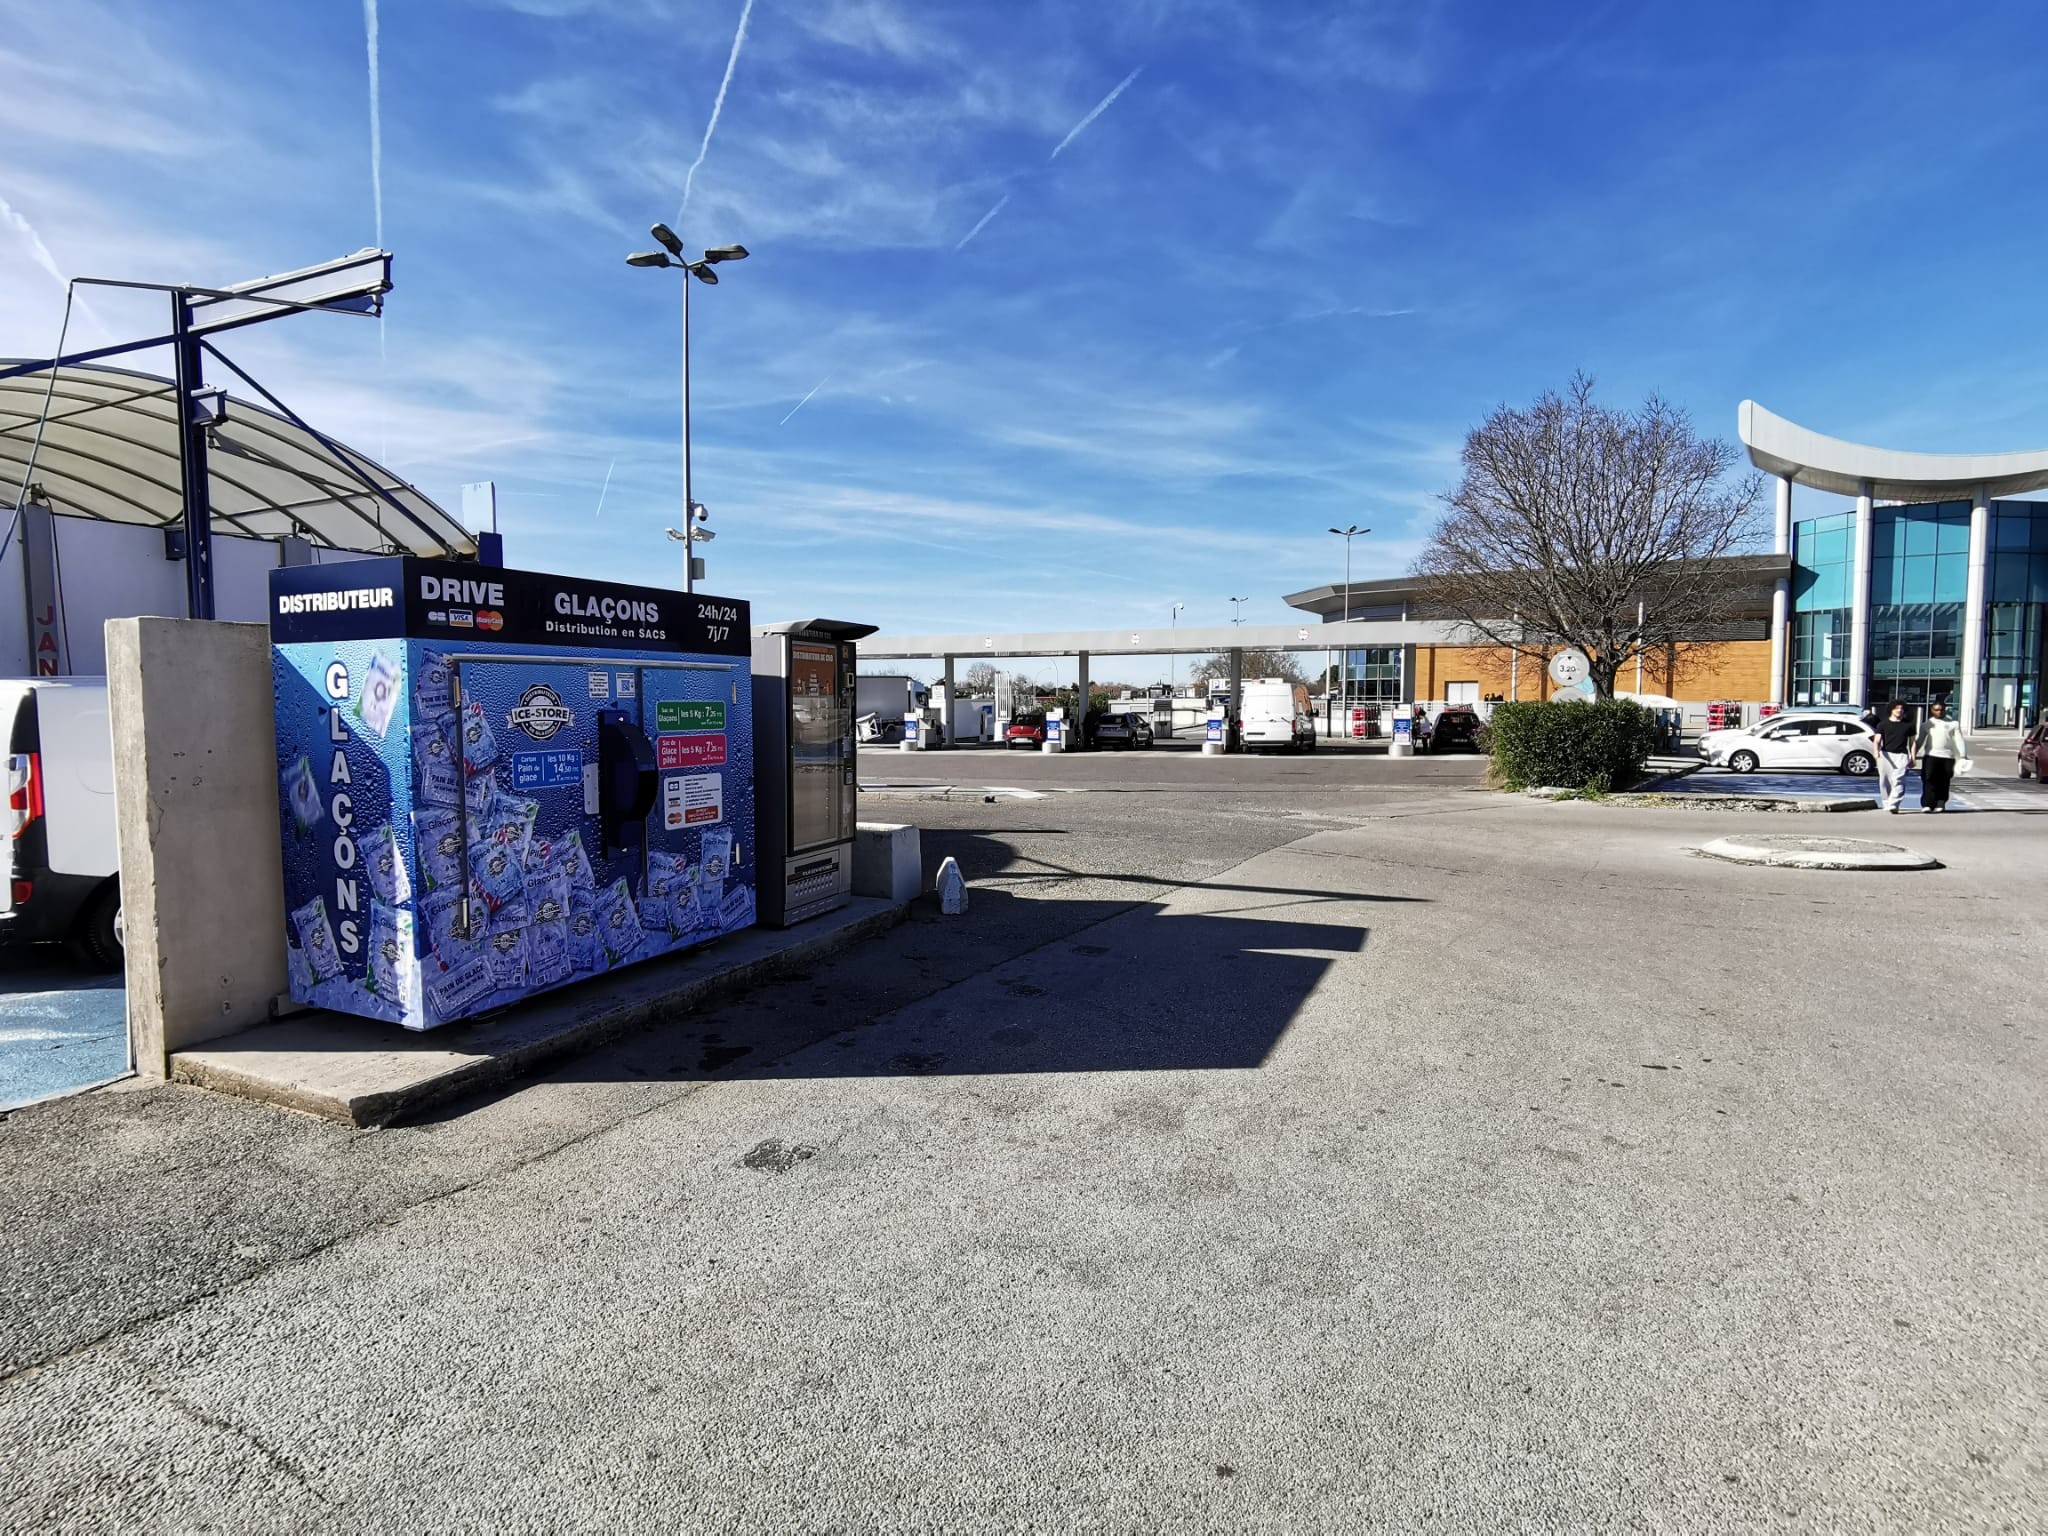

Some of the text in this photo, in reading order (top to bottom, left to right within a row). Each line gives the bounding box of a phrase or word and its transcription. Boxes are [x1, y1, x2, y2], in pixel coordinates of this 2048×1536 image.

[421, 576, 504, 606] DRIVE
[279, 587, 393, 614] DISTRIBUTEUR
[554, 592, 659, 624] GLAÇONS
[697, 604, 738, 622] 24h/24
[546, 621, 666, 640] Distribution en SACS
[707, 626, 729, 643] 7j/7
[514, 708, 568, 721] ICE-STORE
[547, 754, 557, 763] les
[558, 754, 566, 762] 10
[567, 753, 575, 763] Kg
[661, 747, 677, 755] Glace
[517, 764, 533, 773] Pain
[519, 774, 538, 784] glace
[327, 663, 359, 955] GLAÇONS
